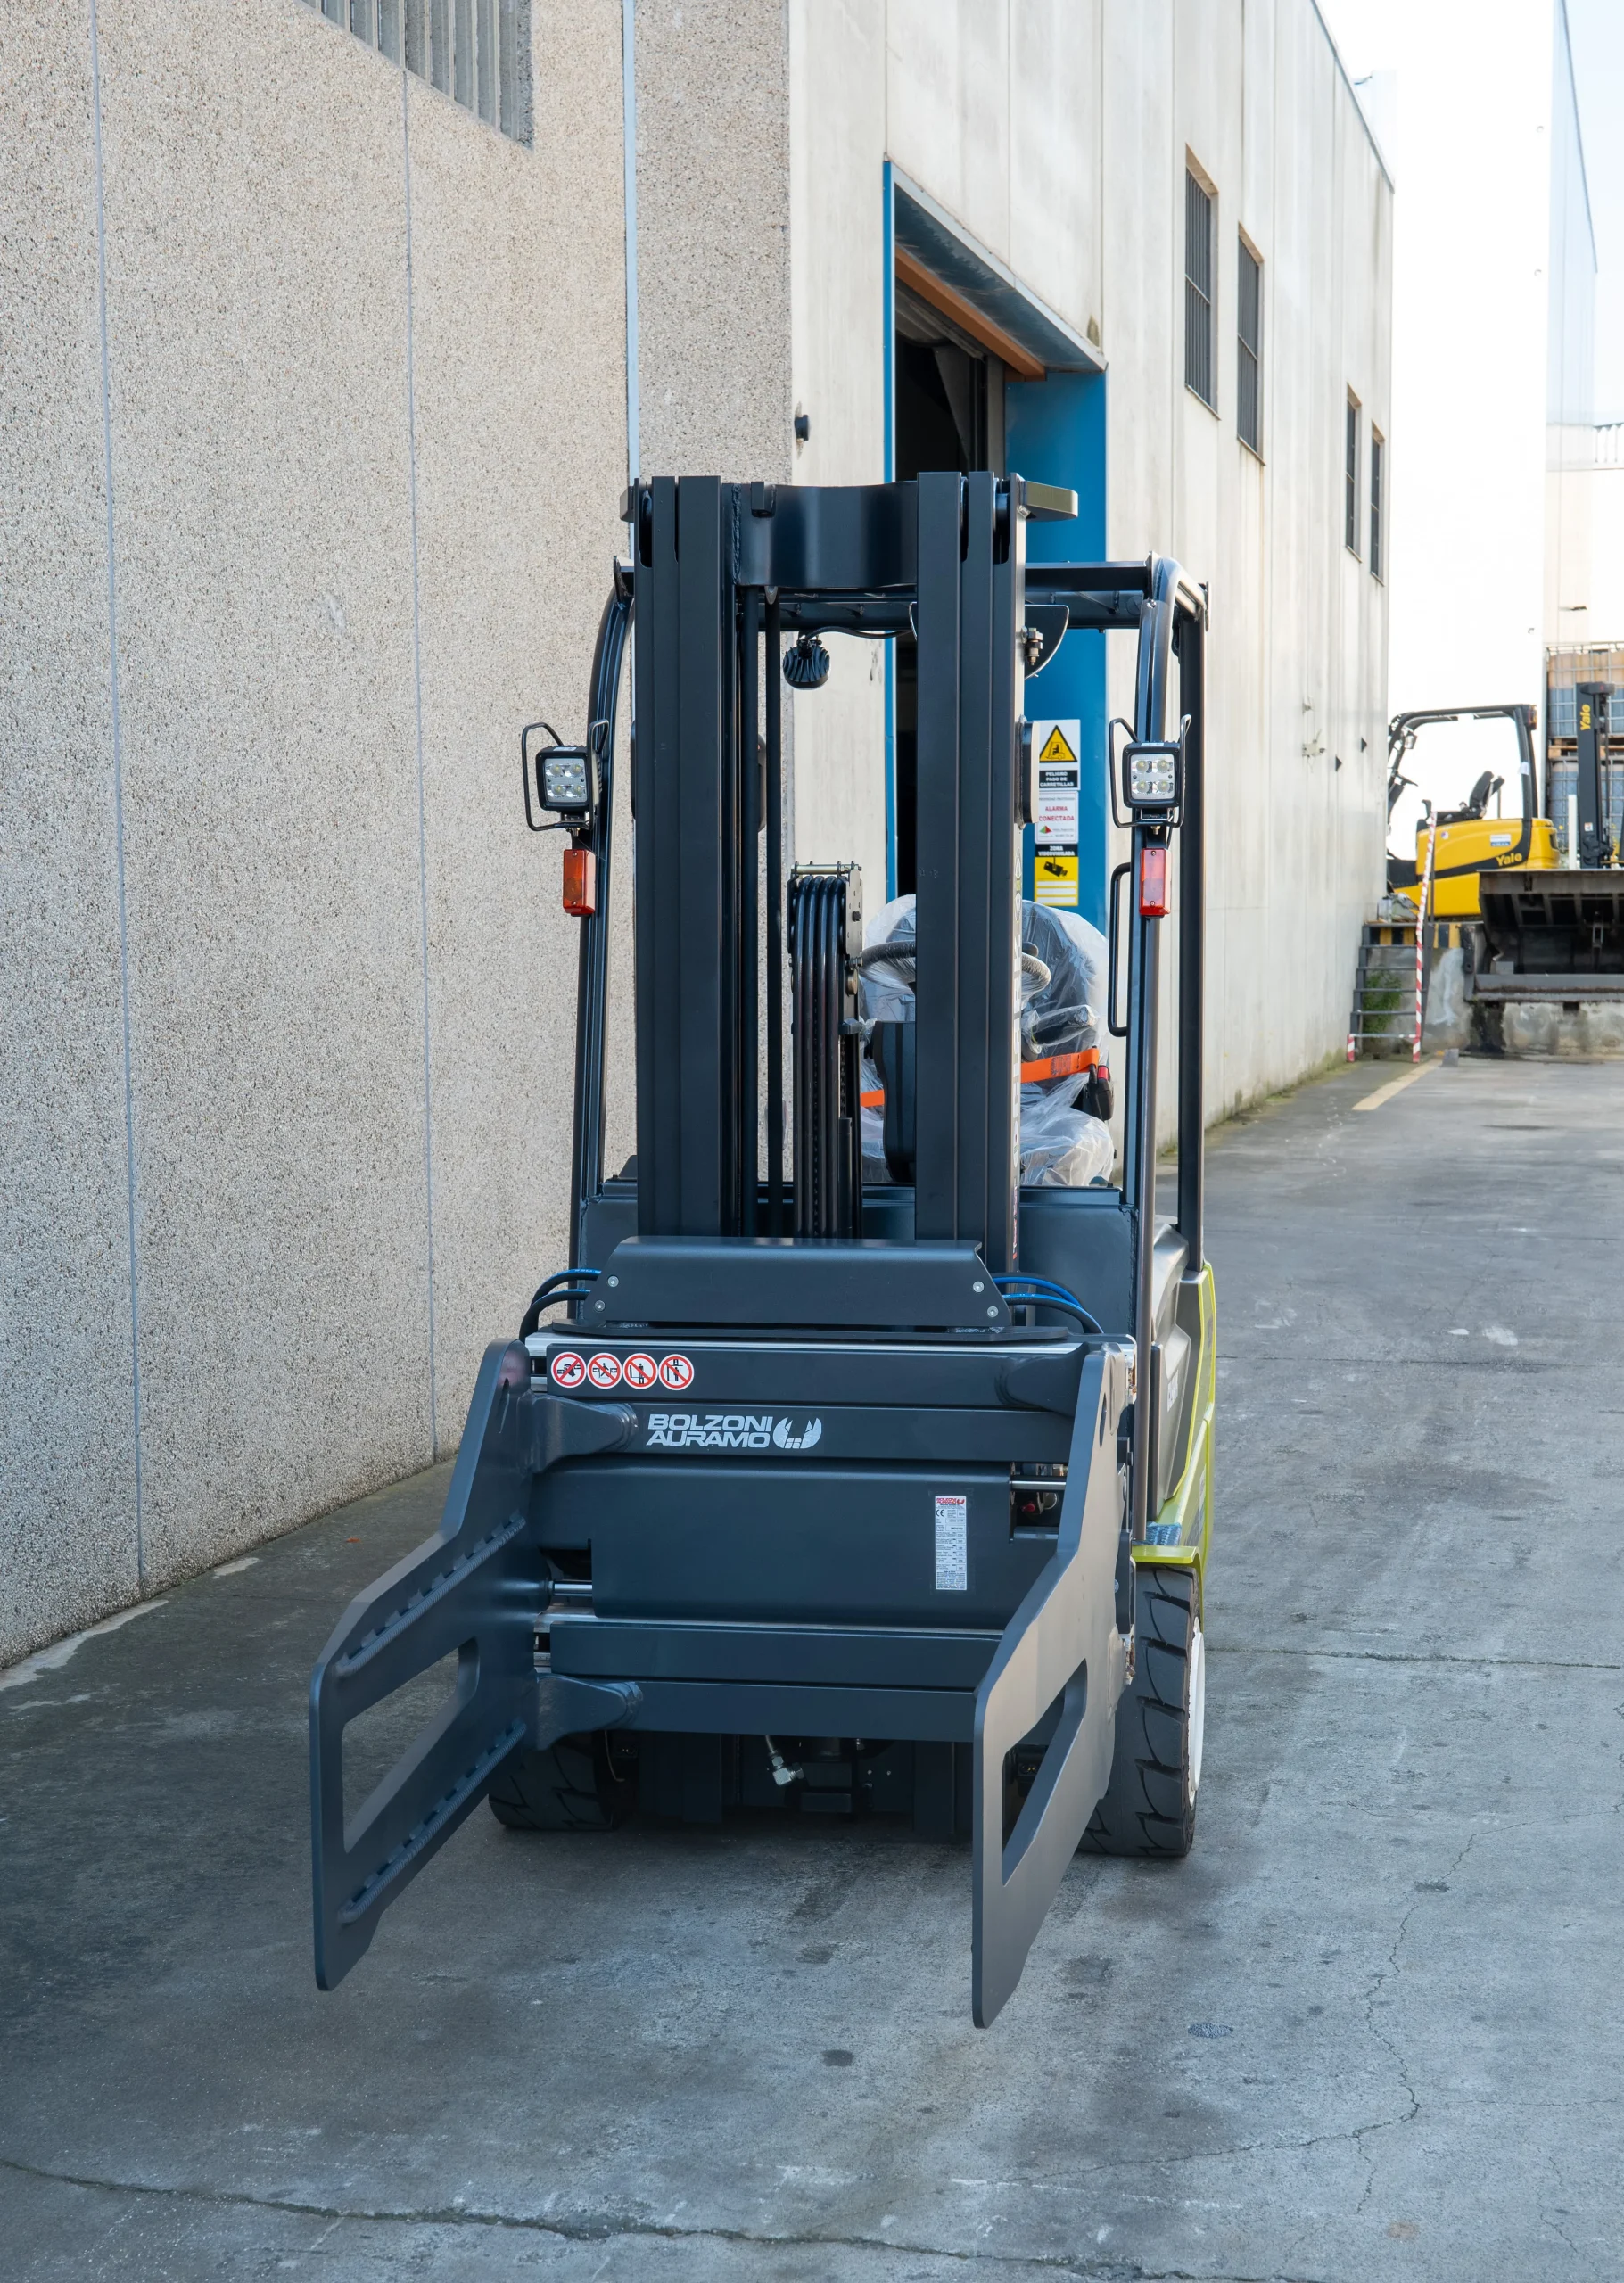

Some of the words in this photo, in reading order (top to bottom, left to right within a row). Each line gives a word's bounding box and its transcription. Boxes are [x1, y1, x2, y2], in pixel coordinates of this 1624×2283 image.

[1580, 704, 1591, 730] Yale
[1496, 853, 1522, 866] Yale
[648, 1414, 773, 1431] BOLZONI
[646, 1430, 771, 1448] AURAMO
